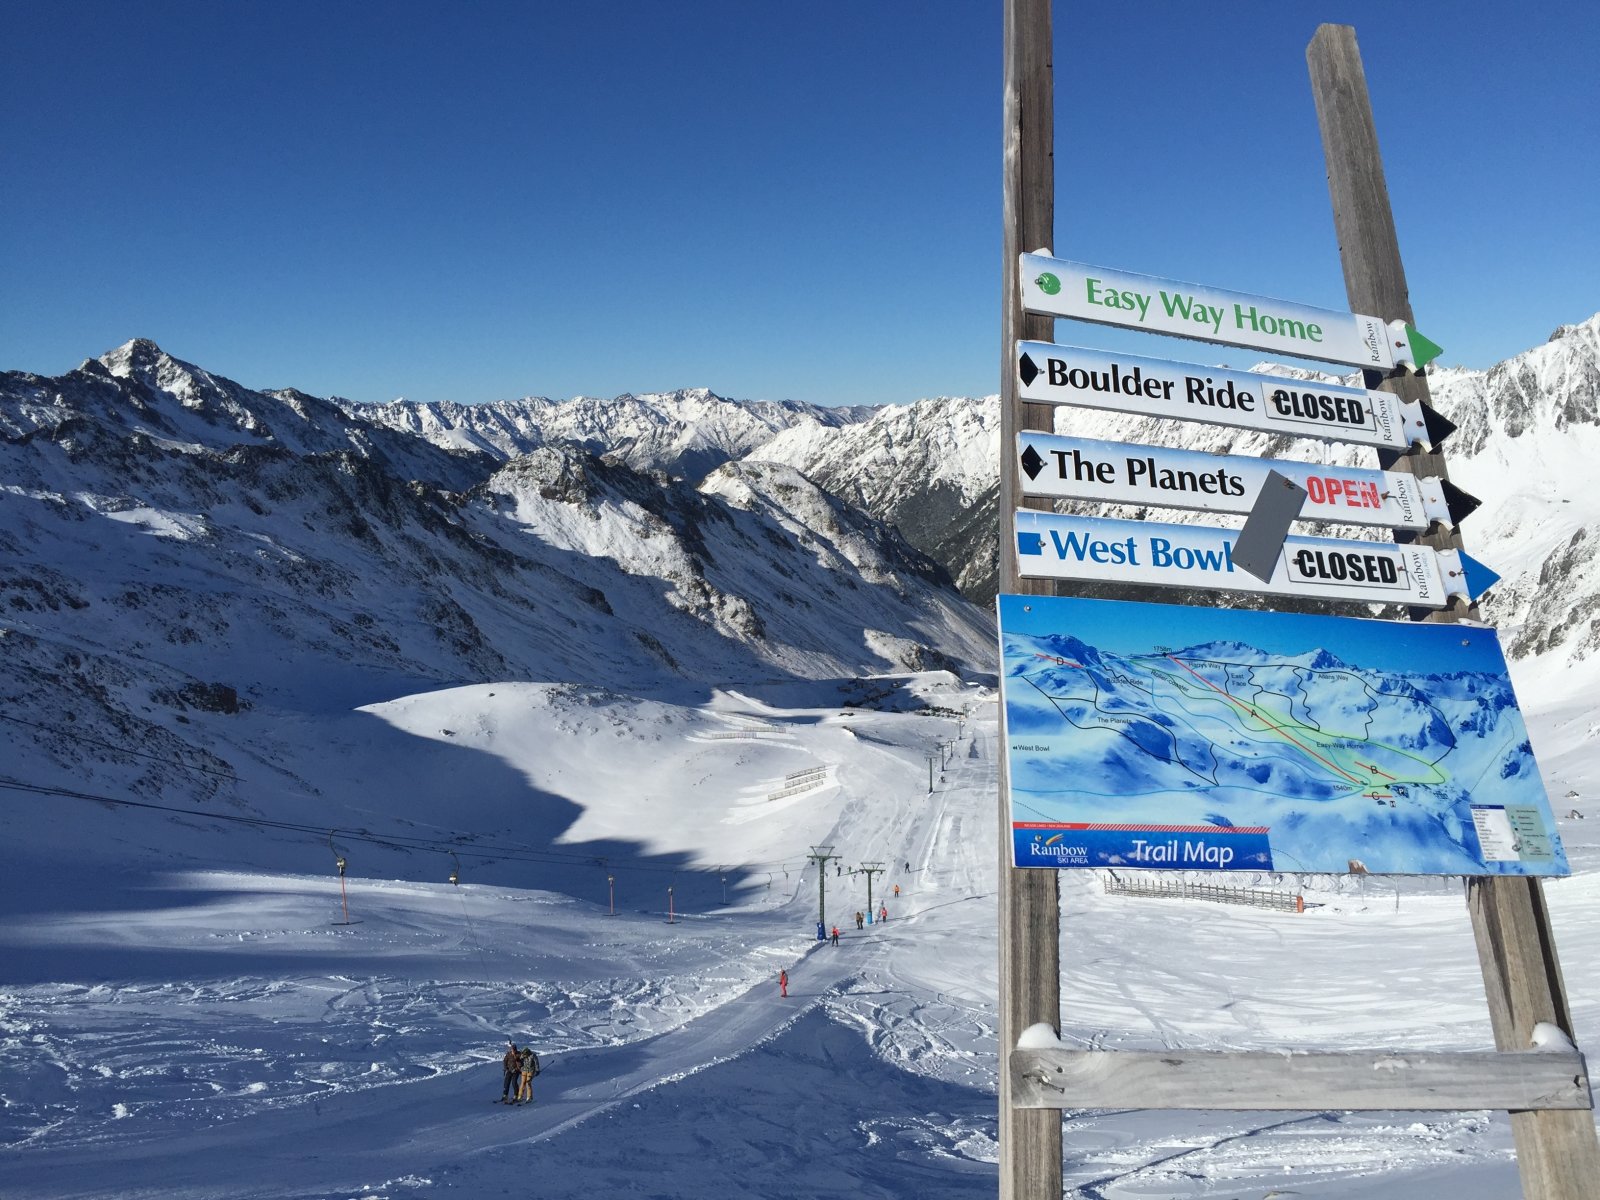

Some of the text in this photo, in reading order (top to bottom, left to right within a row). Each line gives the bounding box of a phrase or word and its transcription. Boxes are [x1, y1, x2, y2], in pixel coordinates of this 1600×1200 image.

[1086, 278, 1323, 342] Easy Way Home
[1366, 321, 1381, 362] Rainbow
[1047, 358, 1255, 412] Boulder Ride
[1275, 389, 1365, 425] CLOSED
[1379, 398, 1393, 441] Rainbow
[1050, 449, 1245, 497] The Planets
[1306, 476, 1381, 509] OPEN
[1397, 479, 1414, 522] Rainbow
[1049, 529, 1235, 573] West Bowl
[1300, 549, 1397, 583] CLOSED
[1413, 552, 1430, 599] Rainbow
[1056, 656, 1064, 665] D
[1250, 709, 1258, 718] A
[1370, 765, 1378, 774] B
[1371, 791, 1379, 800] C
[1030, 842, 1088, 856] Rainbow
[1132, 839, 1233, 865] Trail Map
